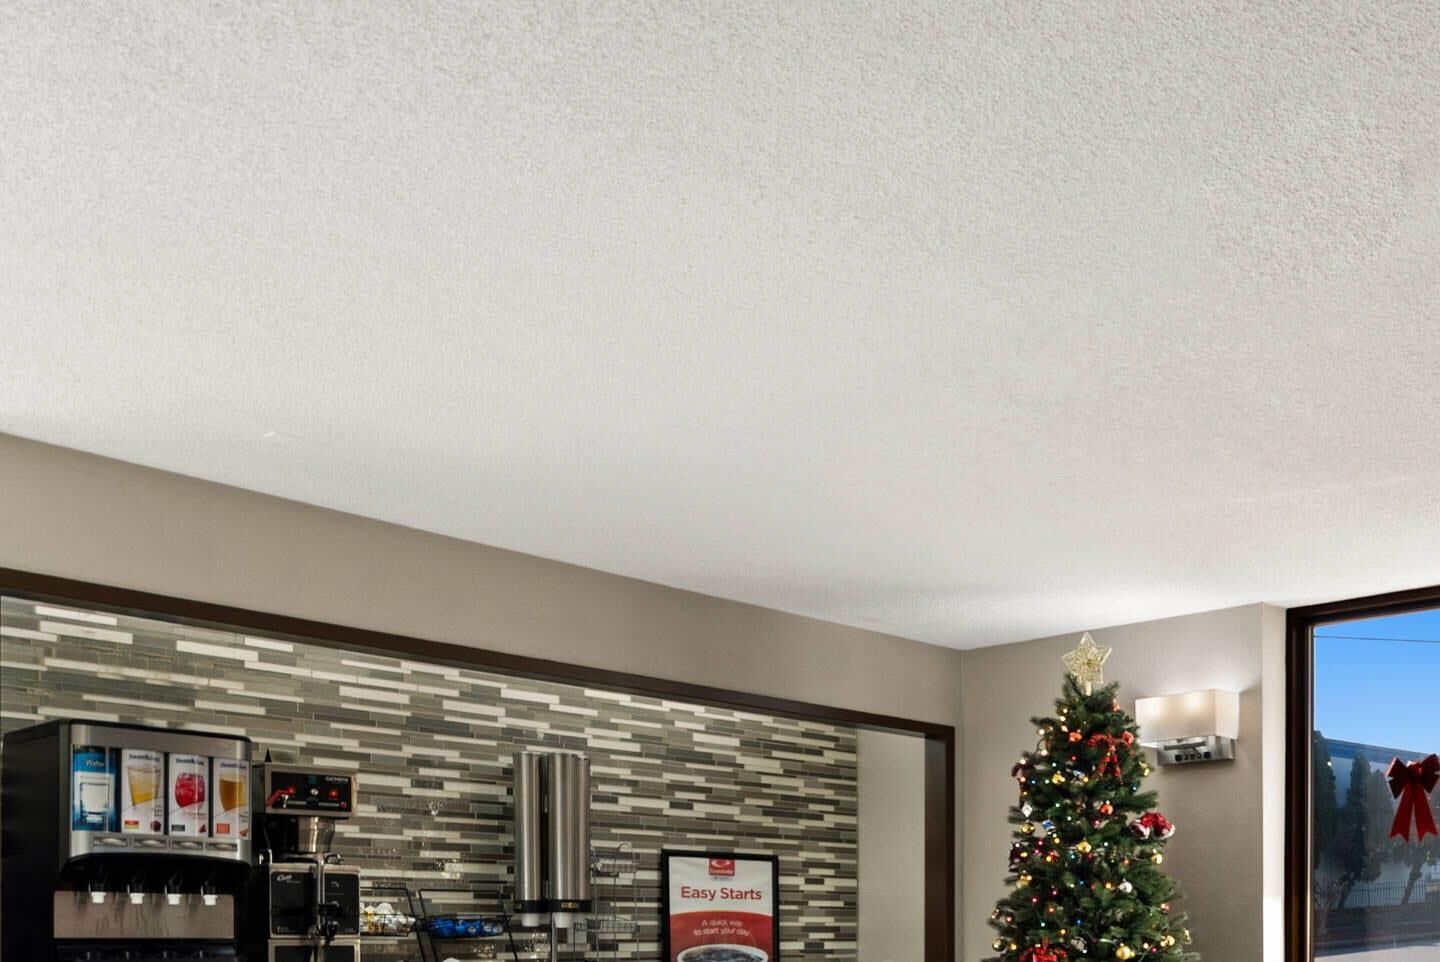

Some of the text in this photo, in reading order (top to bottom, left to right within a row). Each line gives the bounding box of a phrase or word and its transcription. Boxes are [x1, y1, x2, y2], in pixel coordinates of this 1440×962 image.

[86, 759, 105, 768] Water
[681, 886, 762, 901] Easy Starts
[709, 920, 727, 928] quick
